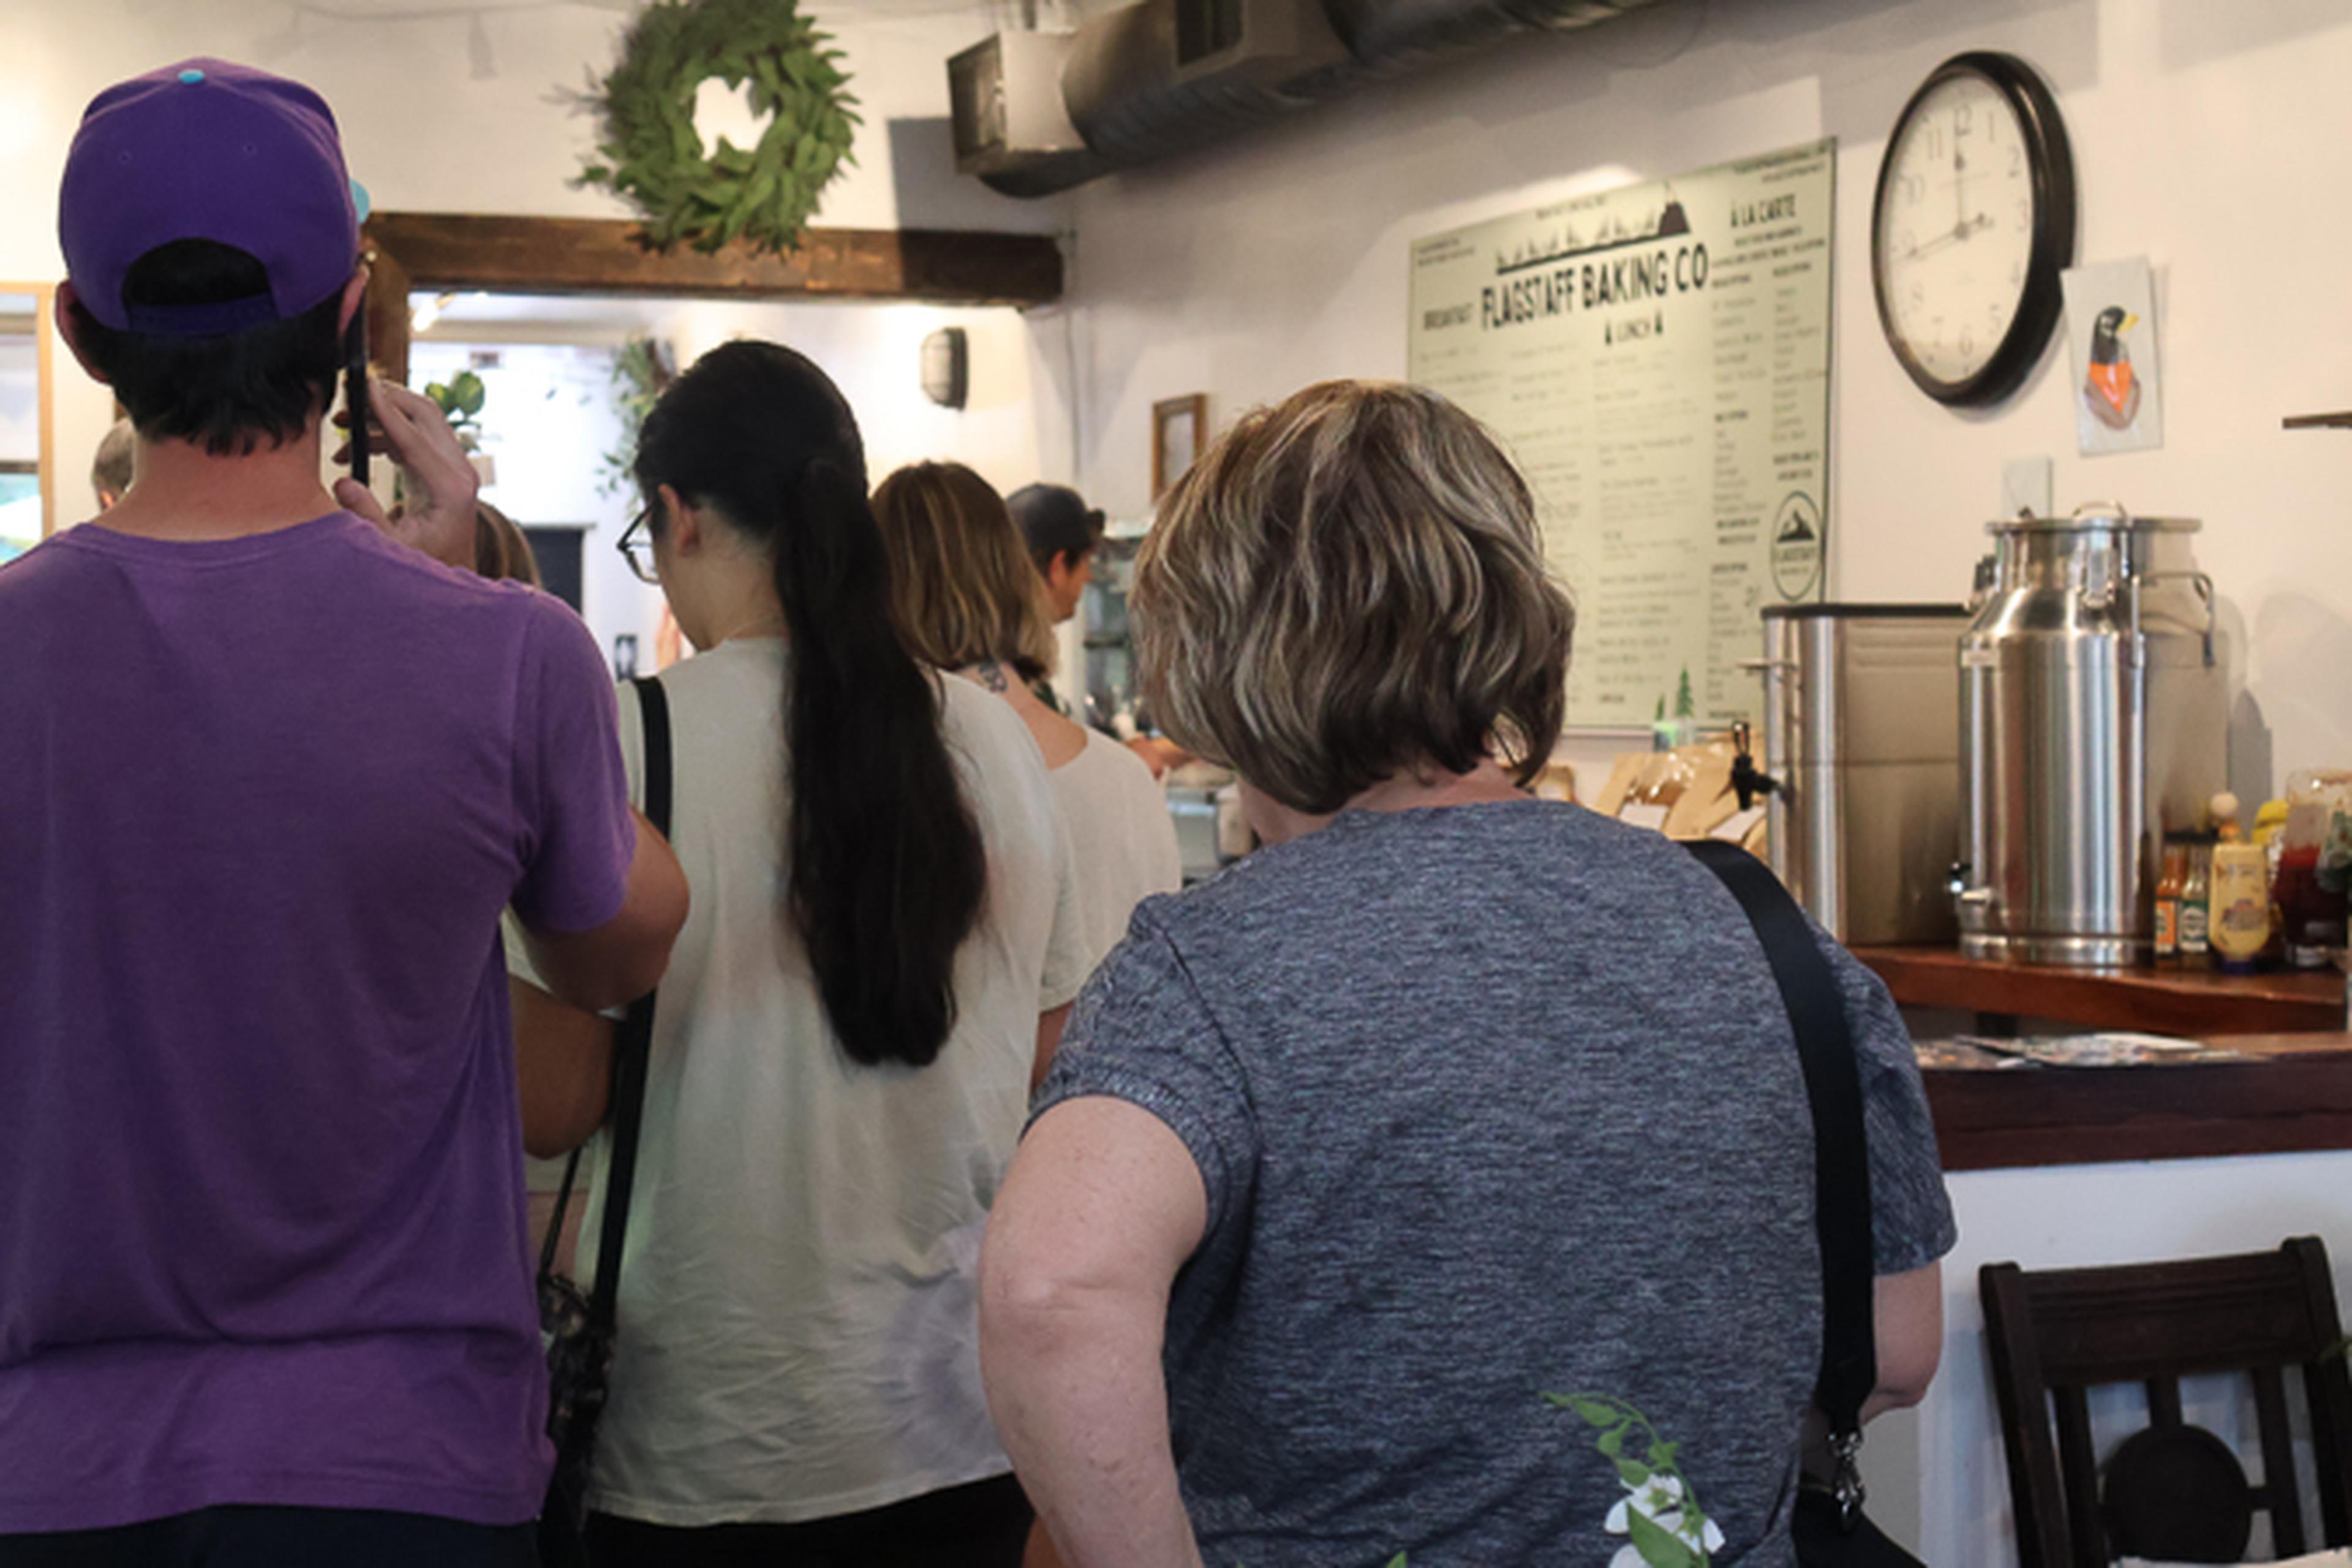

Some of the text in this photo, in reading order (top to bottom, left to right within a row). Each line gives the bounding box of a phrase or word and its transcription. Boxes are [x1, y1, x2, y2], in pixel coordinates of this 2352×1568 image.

[1927, 127, 1943, 161] 11
[1987, 110, 1996, 143] 1
[2007, 143, 2021, 179] 2
[1741, 204, 1756, 227] LA
[1758, 194, 1796, 224] CARTE
[2015, 197, 2029, 233] 3
[1481, 268, 1575, 331] FLAGSTAFF
[1581, 249, 1669, 309] BAKING
[1674, 243, 1709, 293] CO
[1958, 322, 1974, 357] 6
